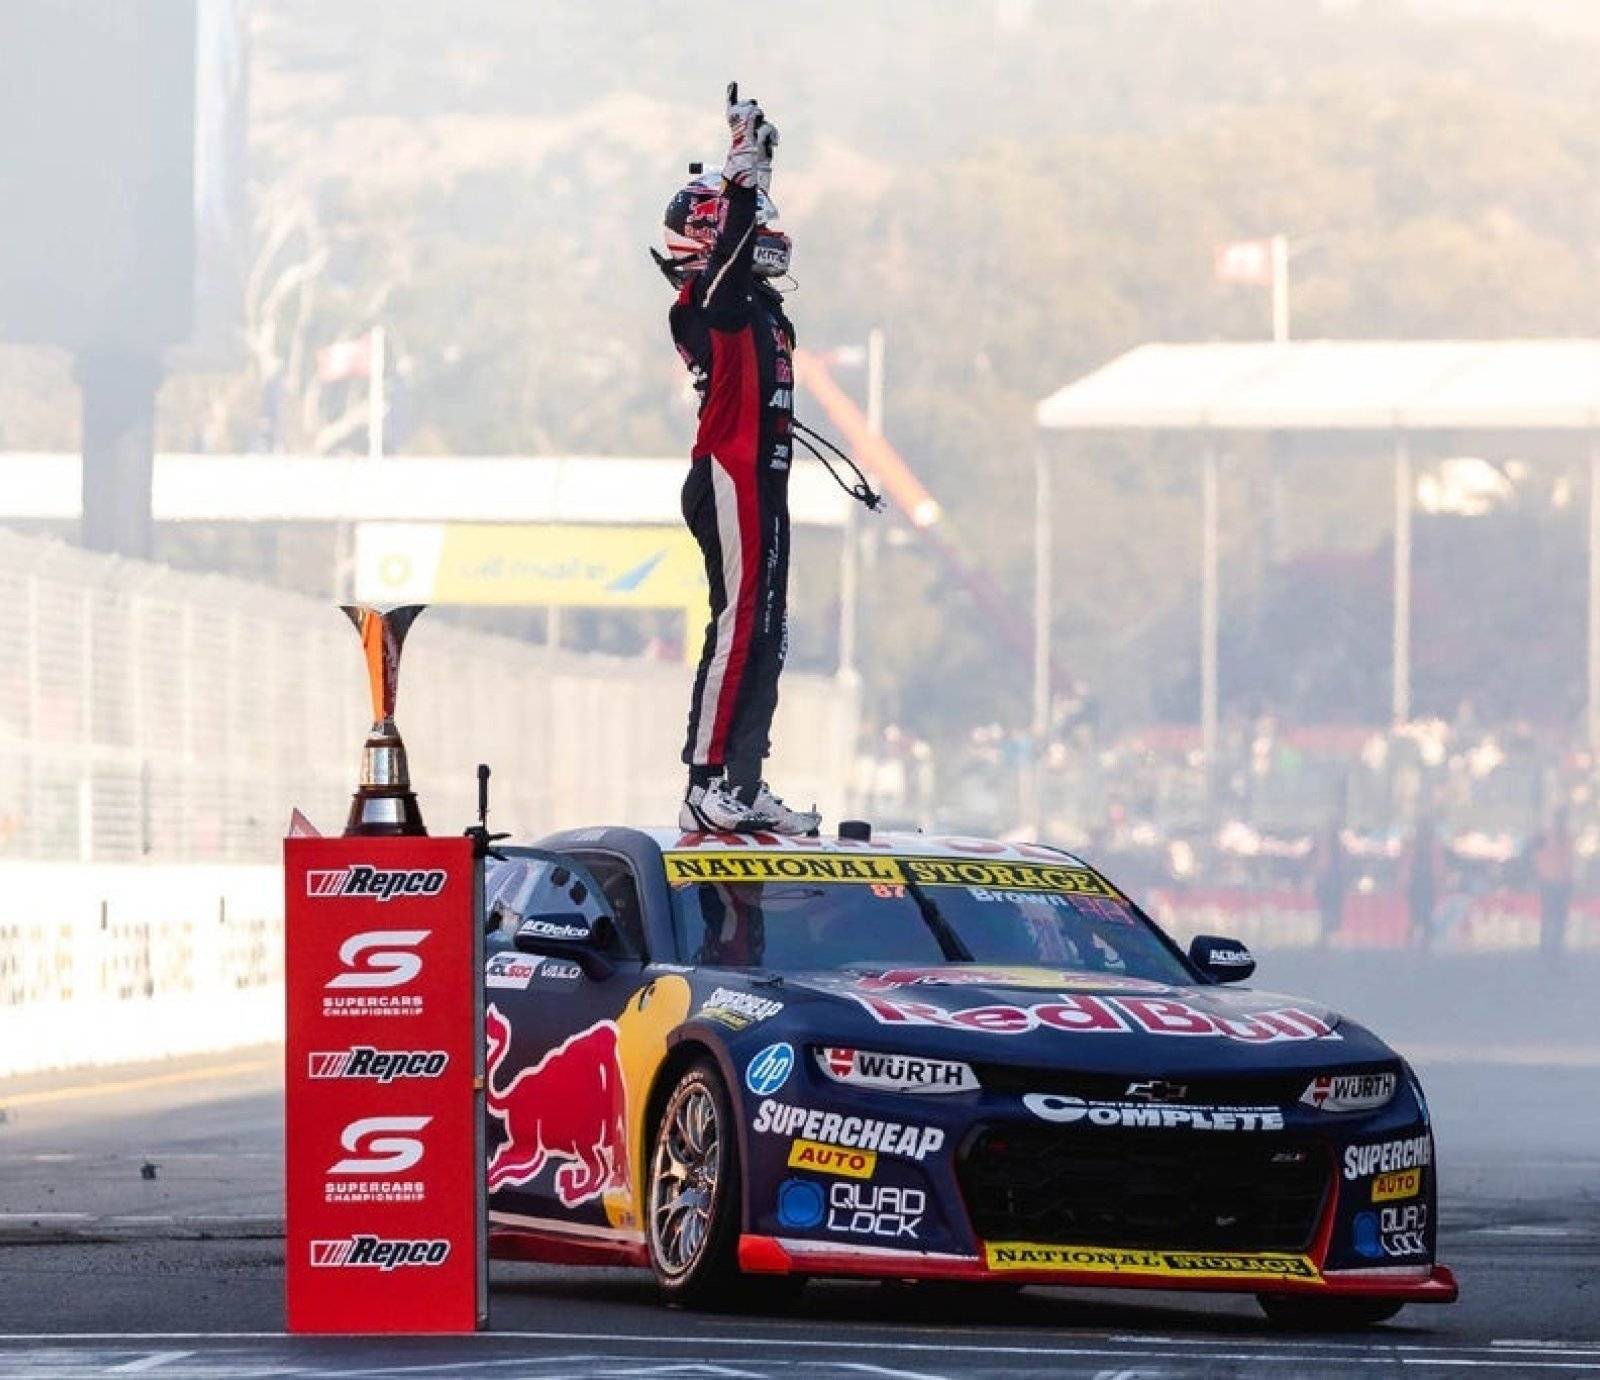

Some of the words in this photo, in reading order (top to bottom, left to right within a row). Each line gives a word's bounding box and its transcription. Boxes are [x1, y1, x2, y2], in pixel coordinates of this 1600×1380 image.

[345, 866, 446, 900] Repco
[671, 859, 892, 879] NATIONAL
[907, 862, 1099, 892] STORAGE
[521, 919, 590, 938] ACDelco
[322, 1007, 423, 1016] CHAMPIONSHIP
[323, 996, 423, 1007] SUPERCARS
[845, 992, 1132, 1034] Red
[1109, 996, 1344, 1043] Bull
[346, 1047, 448, 1082] Repco
[749, 1043, 793, 1095] hp
[859, 1055, 964, 1086] WÜRTH
[1022, 1092, 1285, 1131] COMPLETE
[753, 1099, 945, 1161] SUPERCHEAP
[799, 1147, 866, 1171] AUTO
[325, 1182, 425, 1193] SUPERCARS
[325, 1193, 425, 1203] CHAMPIONSHIP
[829, 1182, 926, 1215] QUAD
[1376, 1175, 1415, 1193] AUTO
[827, 1211, 923, 1239] LOCK
[348, 1235, 449, 1271] Repco
[995, 1247, 1163, 1268] NATIONAL
